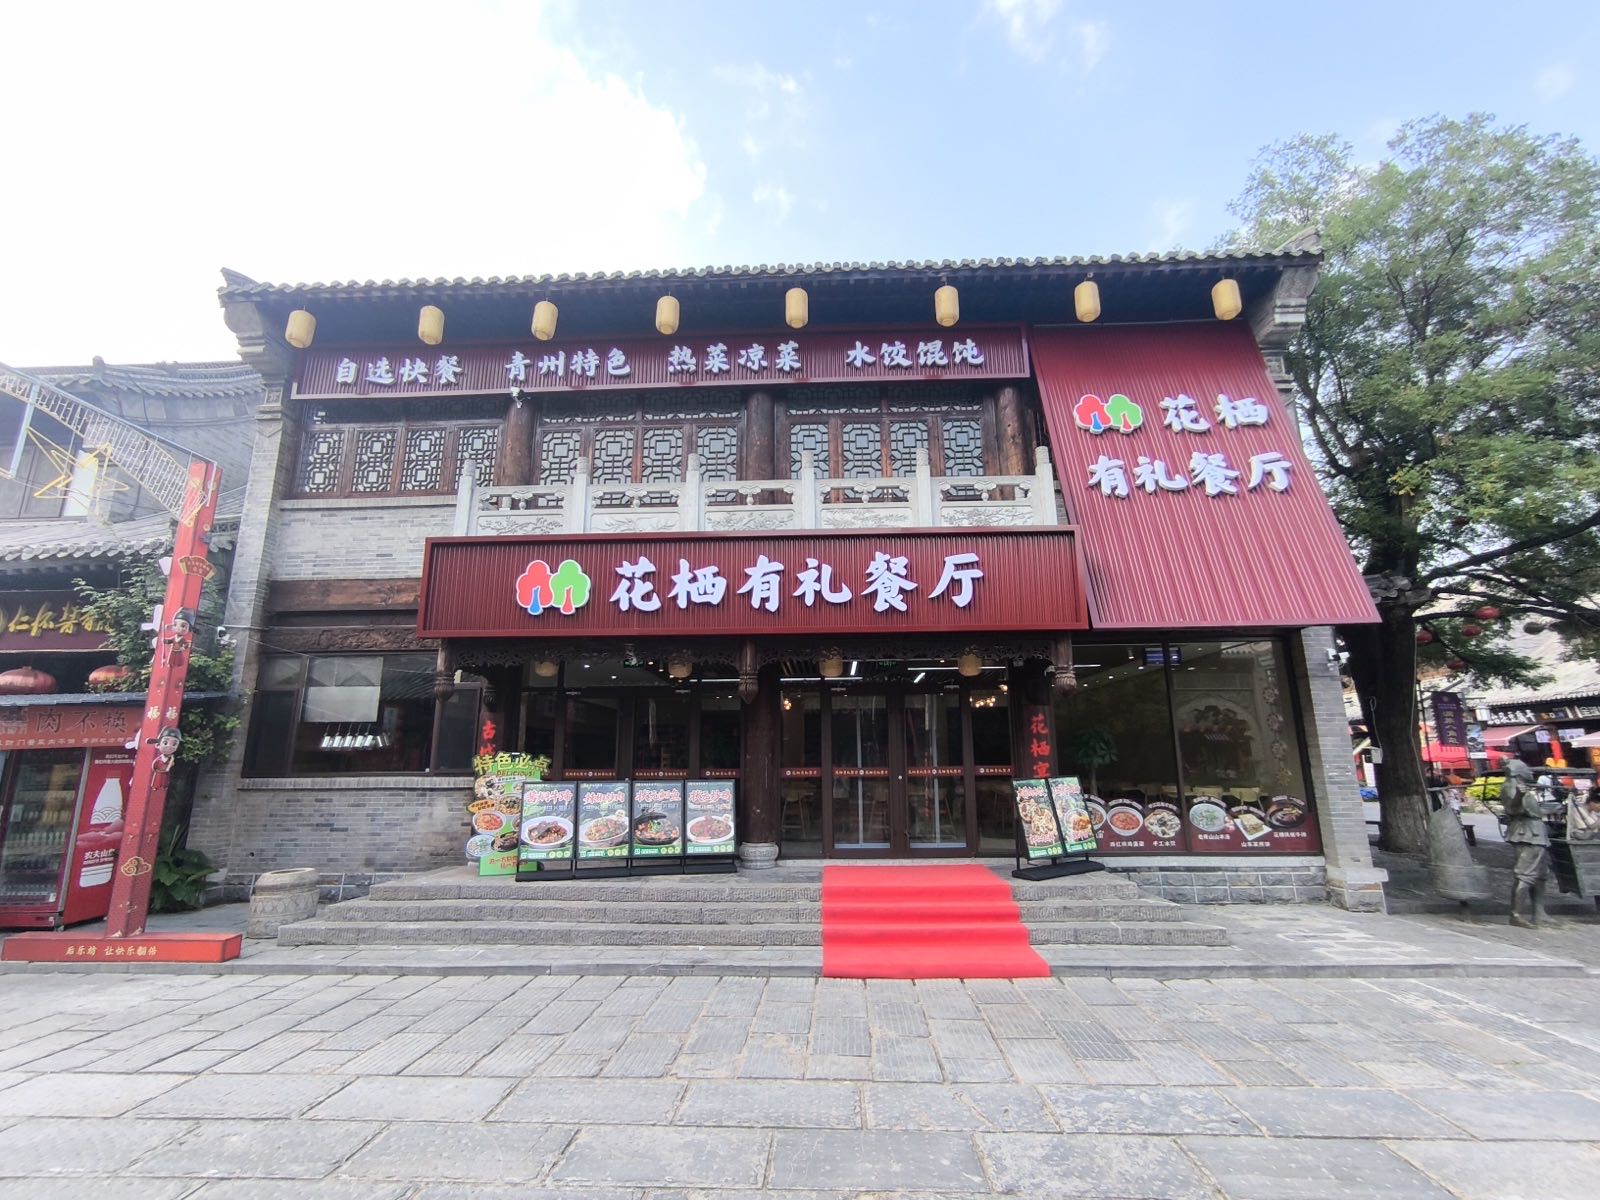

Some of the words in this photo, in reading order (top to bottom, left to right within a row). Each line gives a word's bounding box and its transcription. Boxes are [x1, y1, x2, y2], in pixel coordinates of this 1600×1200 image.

[335, 355, 464, 385] 自选快餐
[504, 348, 631, 382] 青州特色
[667, 340, 802, 374] 热菜凉菜
[846, 338, 985, 369] 水饺馄饨
[1158, 393, 1270, 434] 花栖
[1087, 451, 1293, 498] 有礼餐厅
[609, 551, 985, 613] 花栖有礼餐厅
[473, 752, 552, 775] 特色必点
